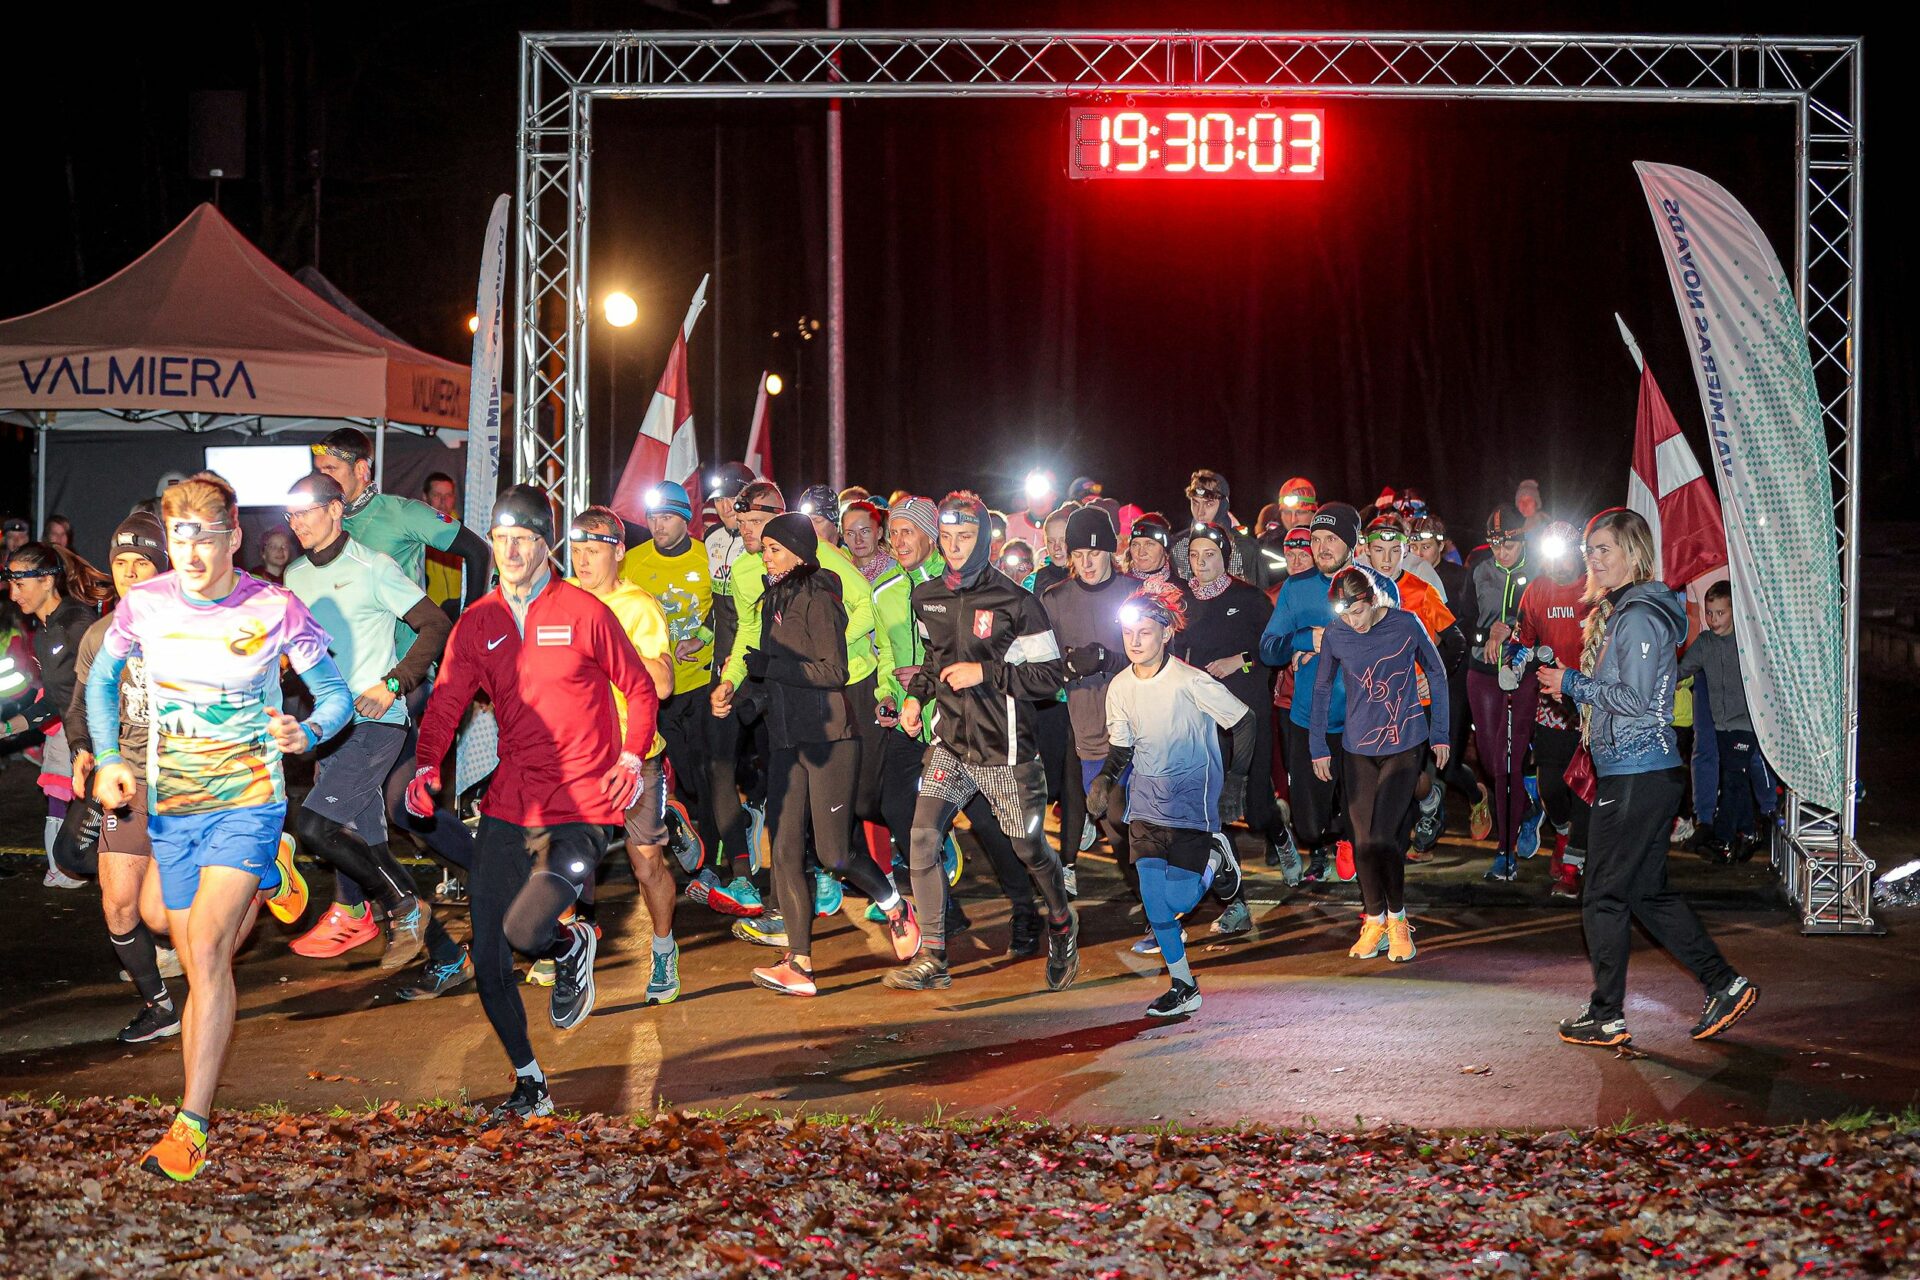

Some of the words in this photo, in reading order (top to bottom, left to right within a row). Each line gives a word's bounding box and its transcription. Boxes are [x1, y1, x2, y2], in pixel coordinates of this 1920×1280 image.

[1099, 112, 1320, 172] 19:30:03
[18, 355, 257, 400] VALMIERA
[1547, 606, 1575, 619] LATVIA
